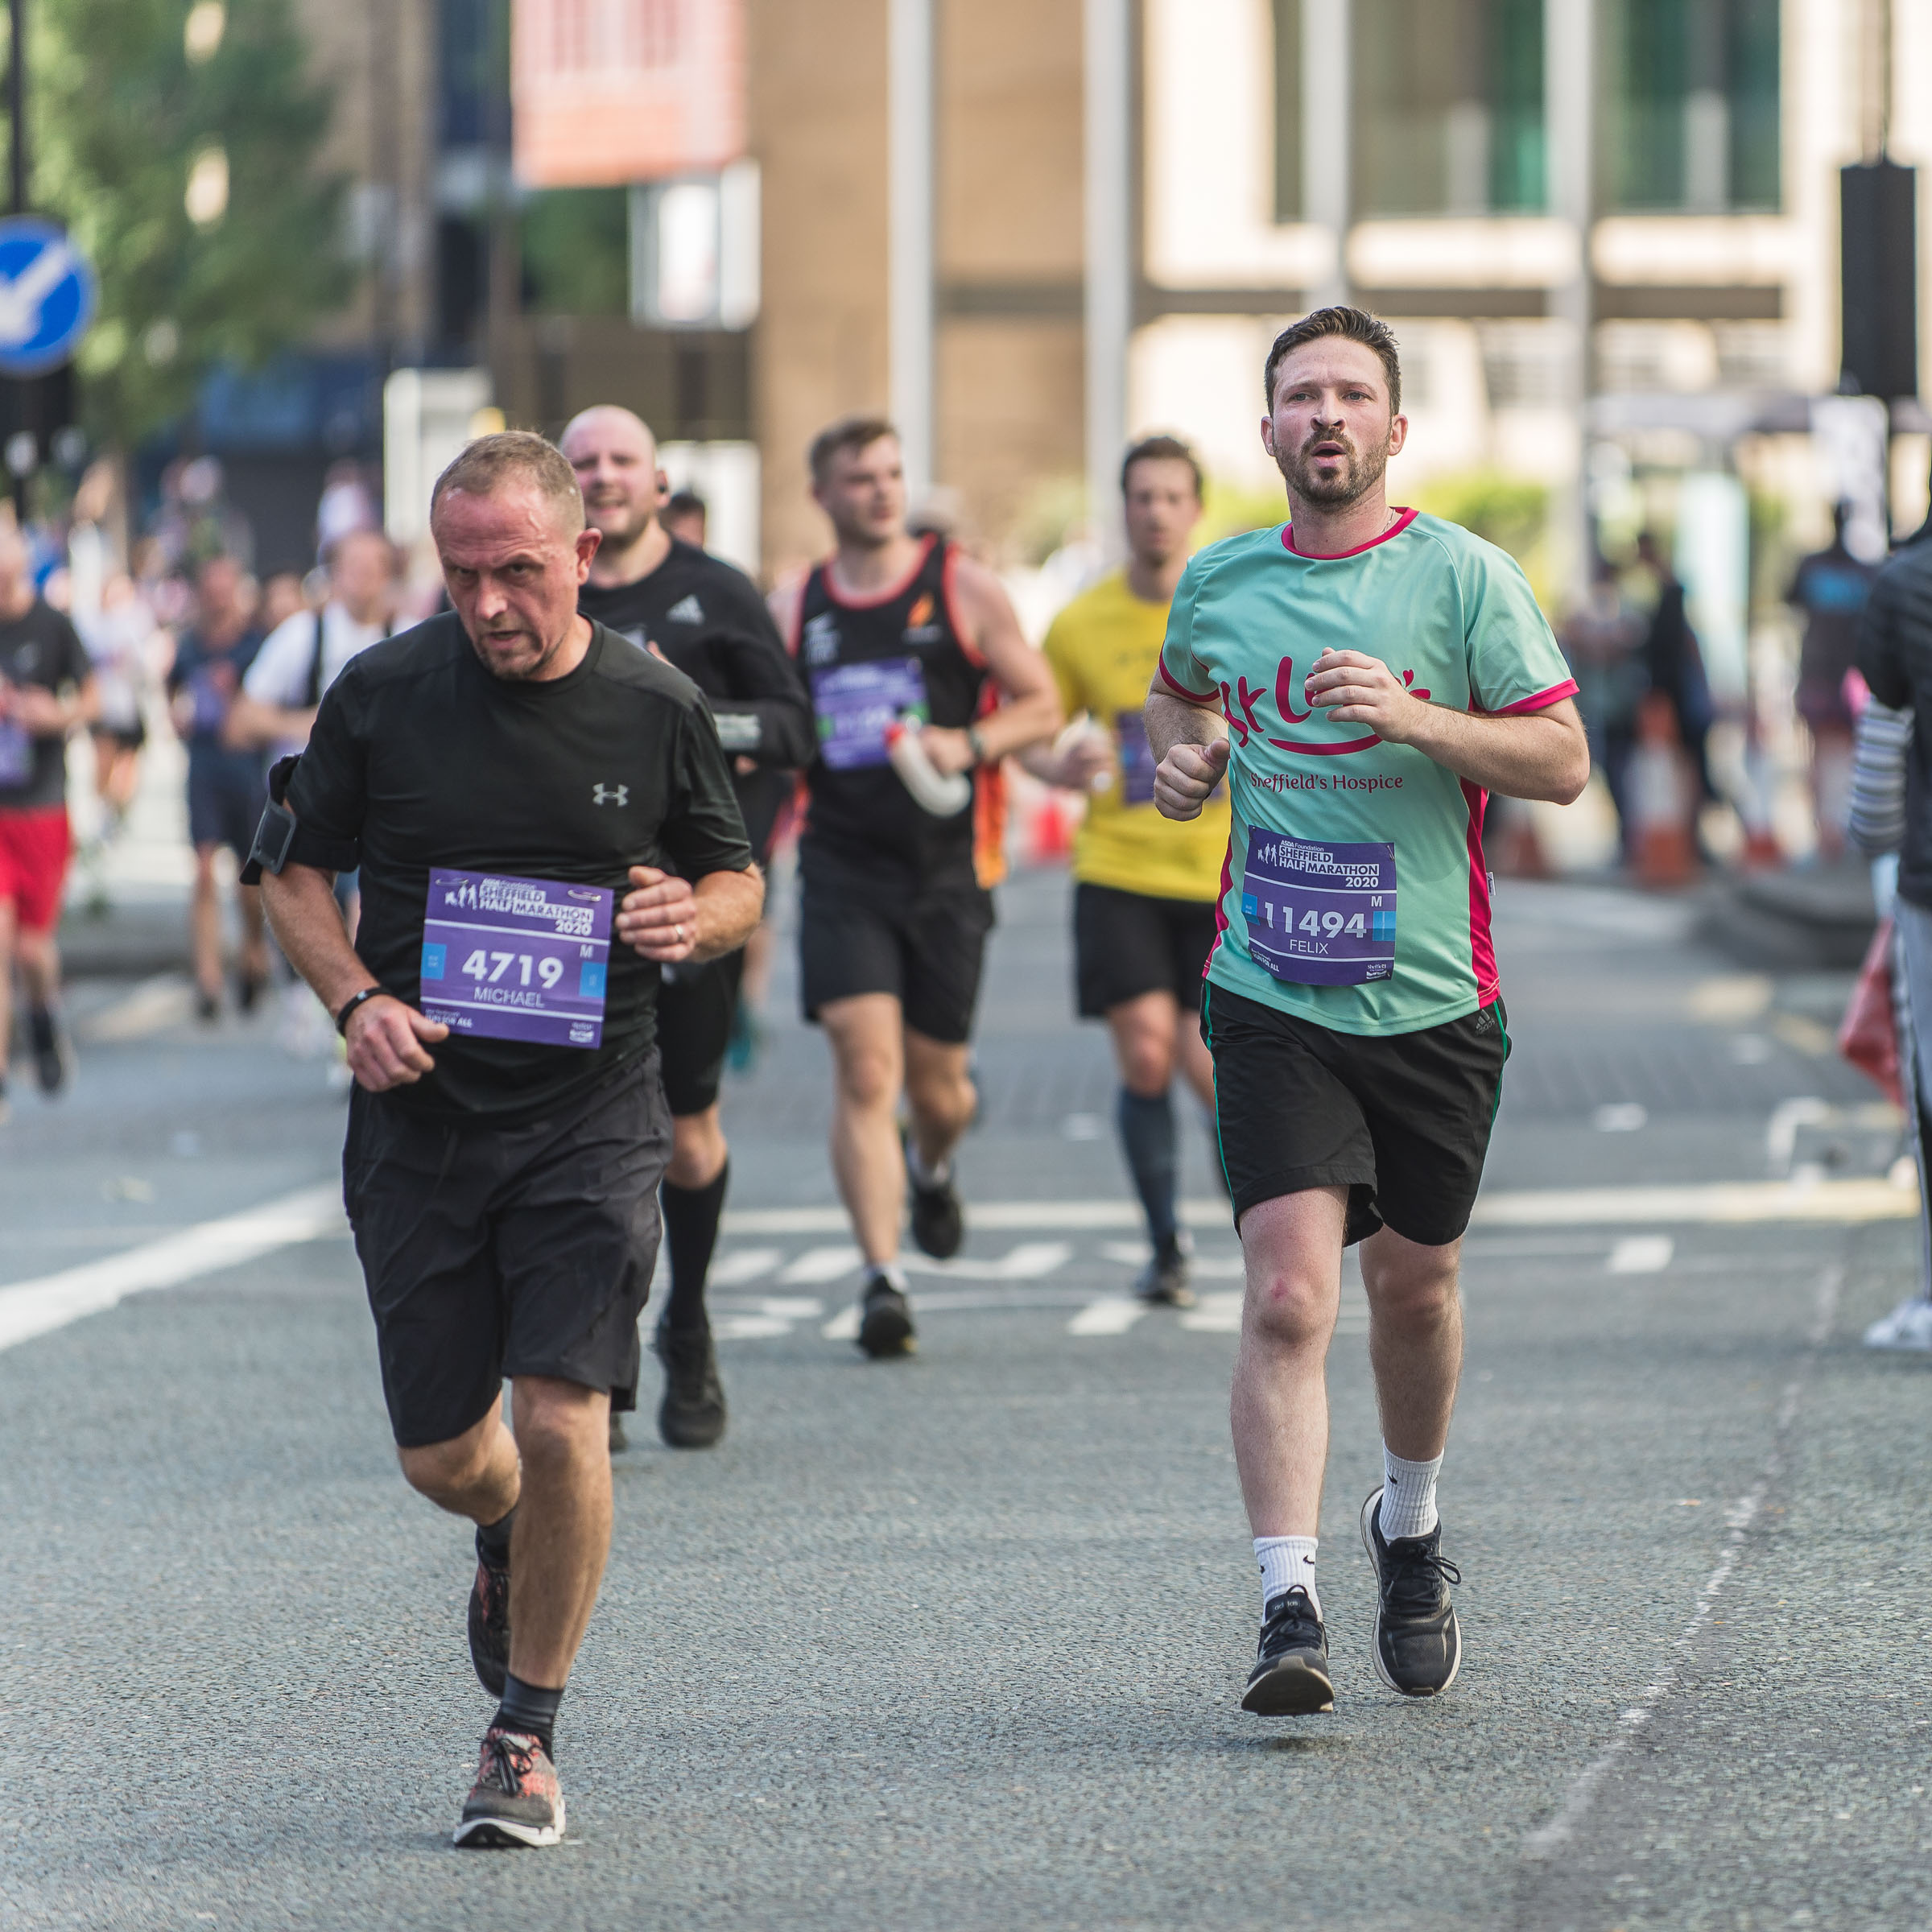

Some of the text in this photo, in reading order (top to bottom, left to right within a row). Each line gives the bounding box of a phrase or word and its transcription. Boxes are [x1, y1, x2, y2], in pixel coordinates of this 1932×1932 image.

[1251, 773, 1403, 793] Sheffield's Hospice
[1280, 846, 1331, 863] SHEFFIELD
[1295, 843, 1324, 852] Foundation
[1279, 857, 1378, 875] HALF MARATHON
[1345, 877, 1379, 888] 2020
[482, 886, 543, 902] SHEFFIELD
[1371, 896, 1382, 907] M
[480, 898, 592, 922] HALF MARATHON
[555, 919, 592, 936] 2020
[1265, 902, 1367, 939] 11494
[579, 944, 594, 958] M
[1290, 939, 1328, 954] FELIX
[461, 950, 564, 989] 4719
[1270, 963, 1280, 972] ALL
[473, 986, 545, 1008] MICHAEL
